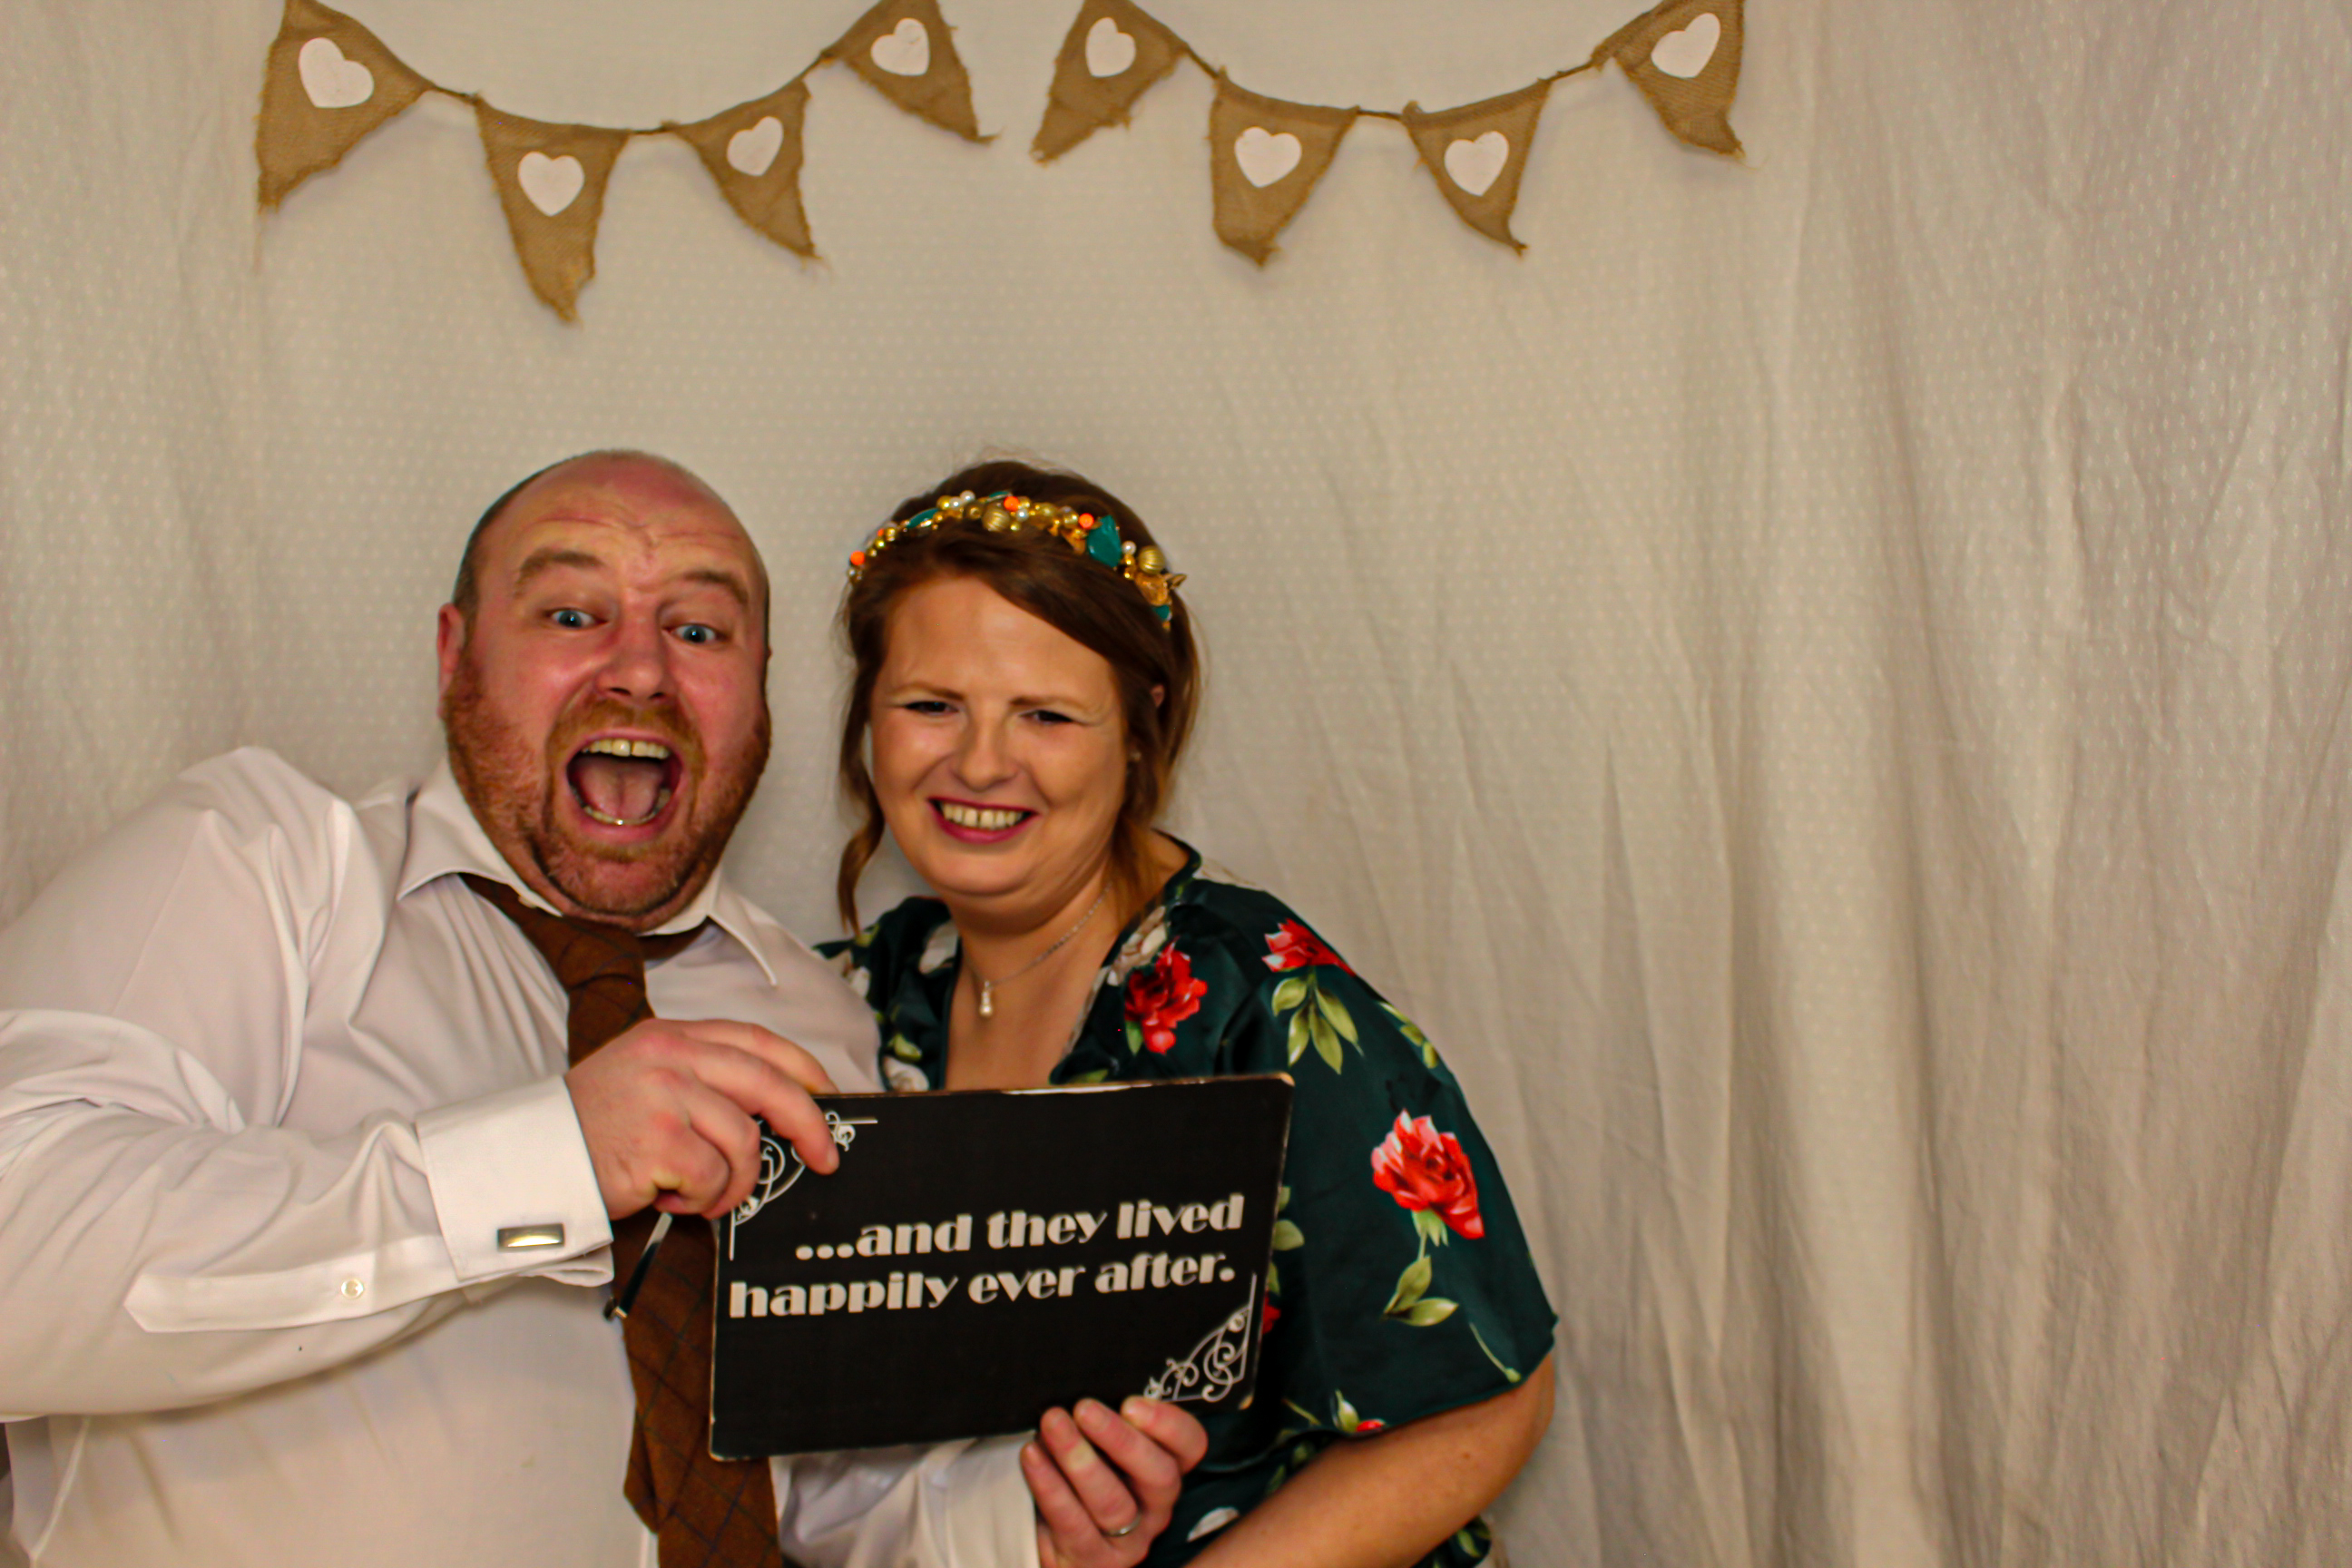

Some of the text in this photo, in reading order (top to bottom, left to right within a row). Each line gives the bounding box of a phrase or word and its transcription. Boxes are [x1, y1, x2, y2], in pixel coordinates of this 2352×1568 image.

[796, 1194, 1245, 1260] ...and they lived
[730, 1253, 1235, 1318] happily ever after.
